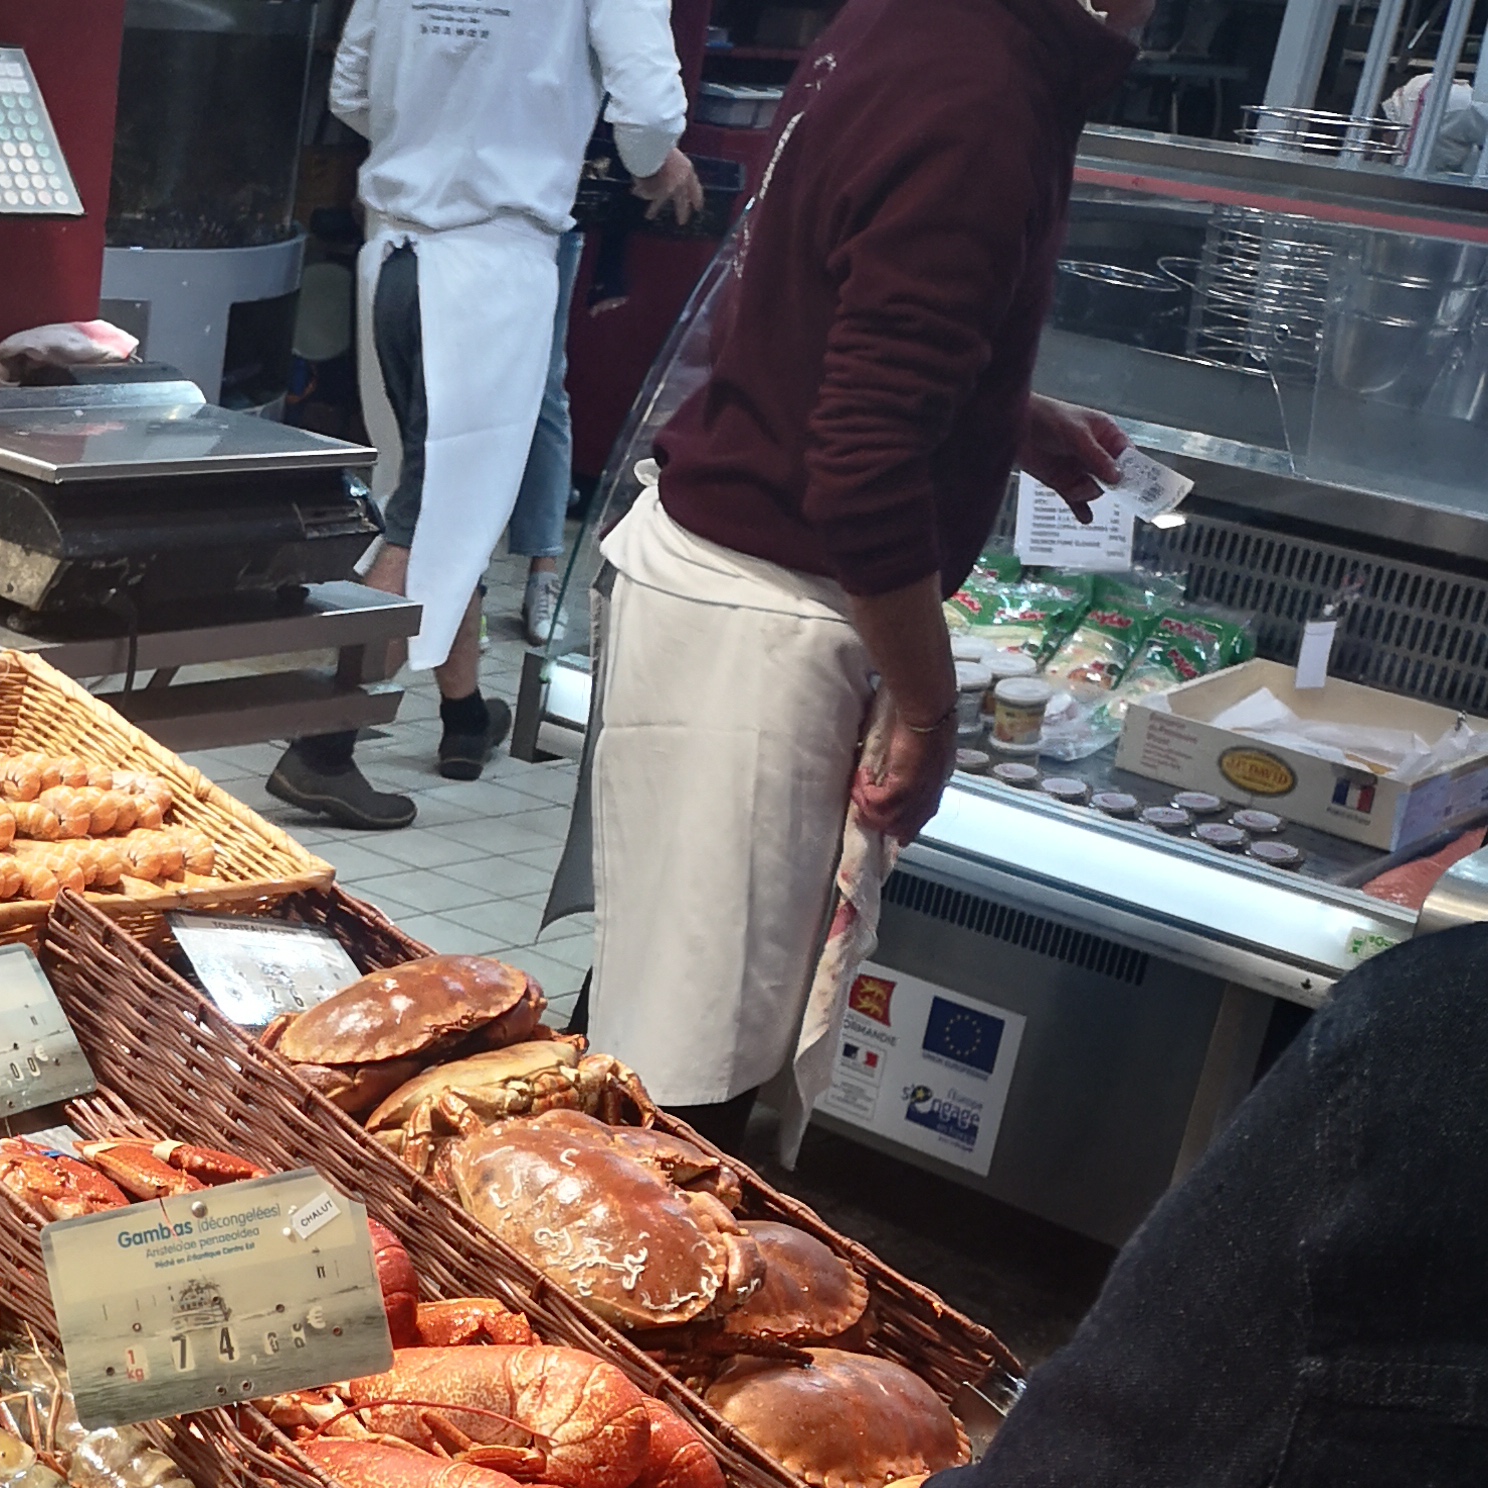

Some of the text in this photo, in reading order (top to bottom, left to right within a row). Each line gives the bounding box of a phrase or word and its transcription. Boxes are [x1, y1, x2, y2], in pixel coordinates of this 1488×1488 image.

[843, 1018, 899, 1047] ORMANDIE
[117, 1219, 194, 1248] Gambas
[300, 1199, 334, 1229] CHALUT
